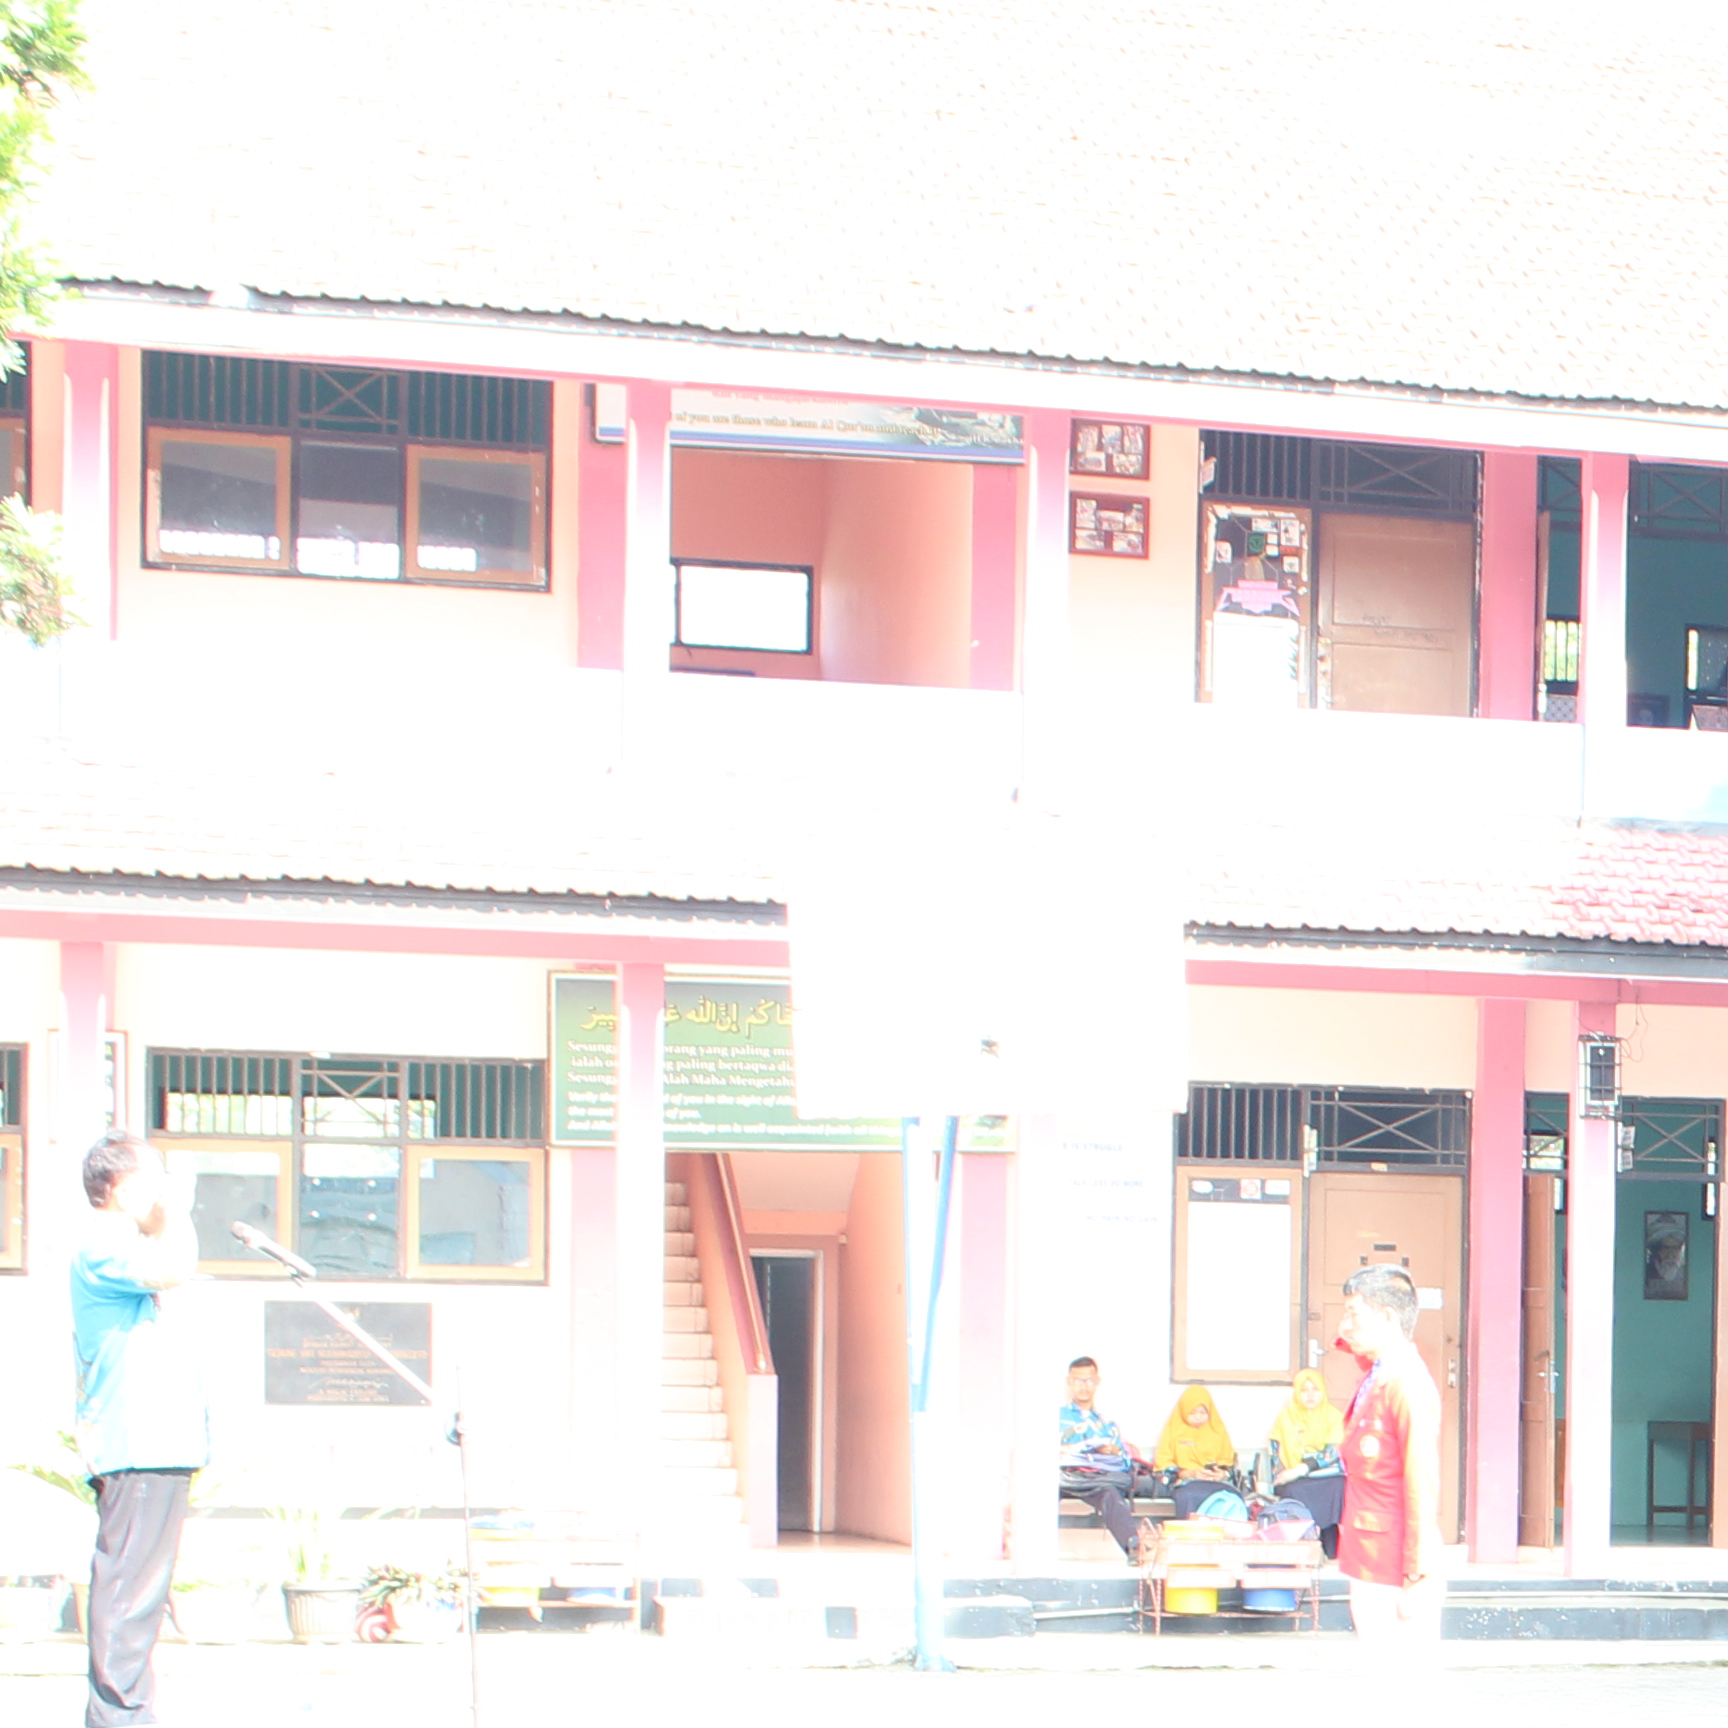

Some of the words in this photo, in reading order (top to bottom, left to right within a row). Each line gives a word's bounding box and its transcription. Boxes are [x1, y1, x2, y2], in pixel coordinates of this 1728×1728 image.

[698, 1045, 729, 1058] yang
[730, 1044, 770, 1058] paling
[570, 1056, 603, 1068] ialah
[676, 1059, 716, 1073] paling
[718, 1059, 776, 1074] bertaqwa
[691, 1073, 727, 1085] Maha
[728, 1074, 795, 1088] Mengetahu
